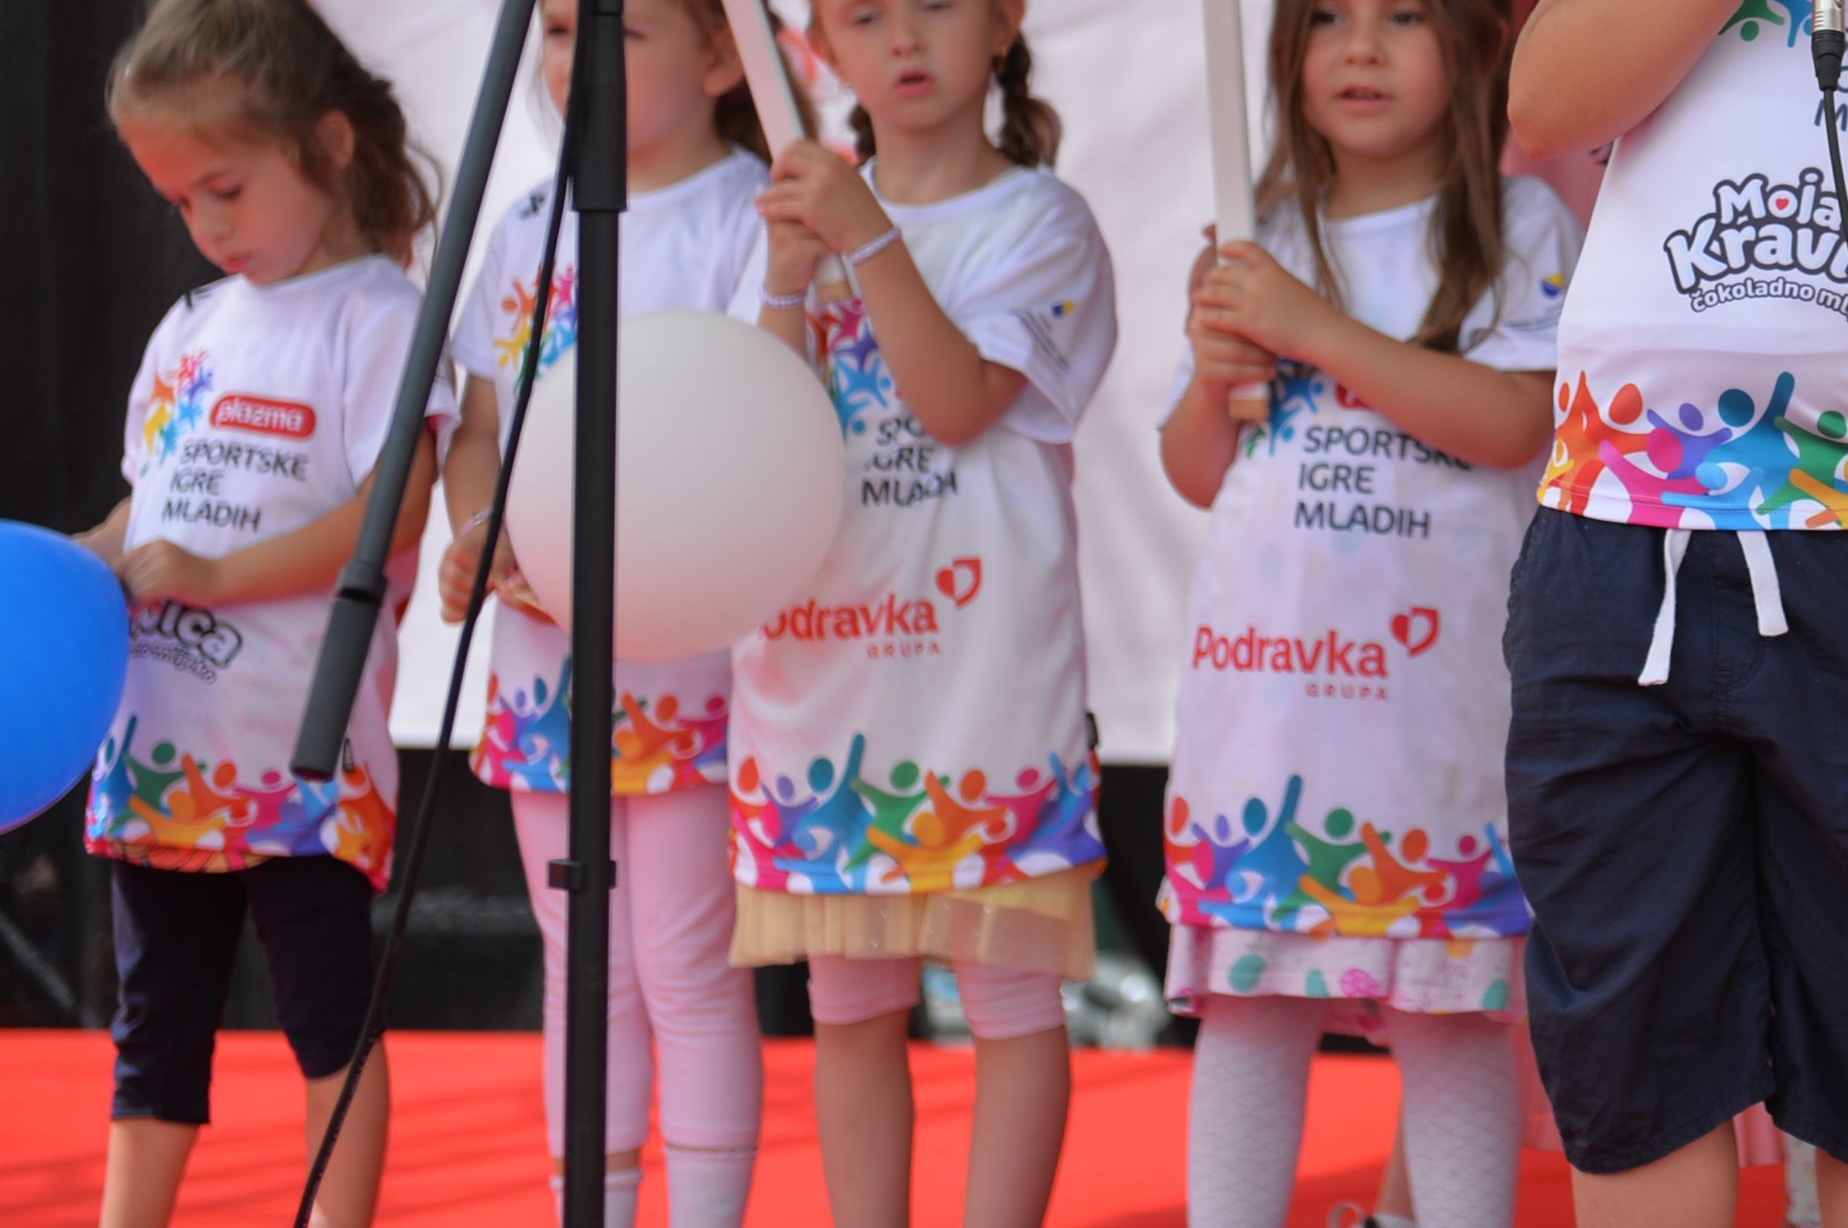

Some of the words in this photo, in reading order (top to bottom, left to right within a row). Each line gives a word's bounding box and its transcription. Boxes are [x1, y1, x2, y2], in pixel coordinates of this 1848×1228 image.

[1713, 167, 1843, 231] Moja
[1690, 276, 1816, 313] čokoladno
[215, 396, 305, 433] plazma
[180, 438, 310, 483] SPORTSKE
[1298, 462, 1376, 495] IGRE
[169, 467, 225, 496] IGRE
[161, 496, 262, 533] MLADIH
[1294, 500, 1431, 540] MLADIH
[866, 641, 942, 660] GRUPA
[1192, 624, 1390, 679] Podravka
[1305, 682, 1390, 702] GRUPA
